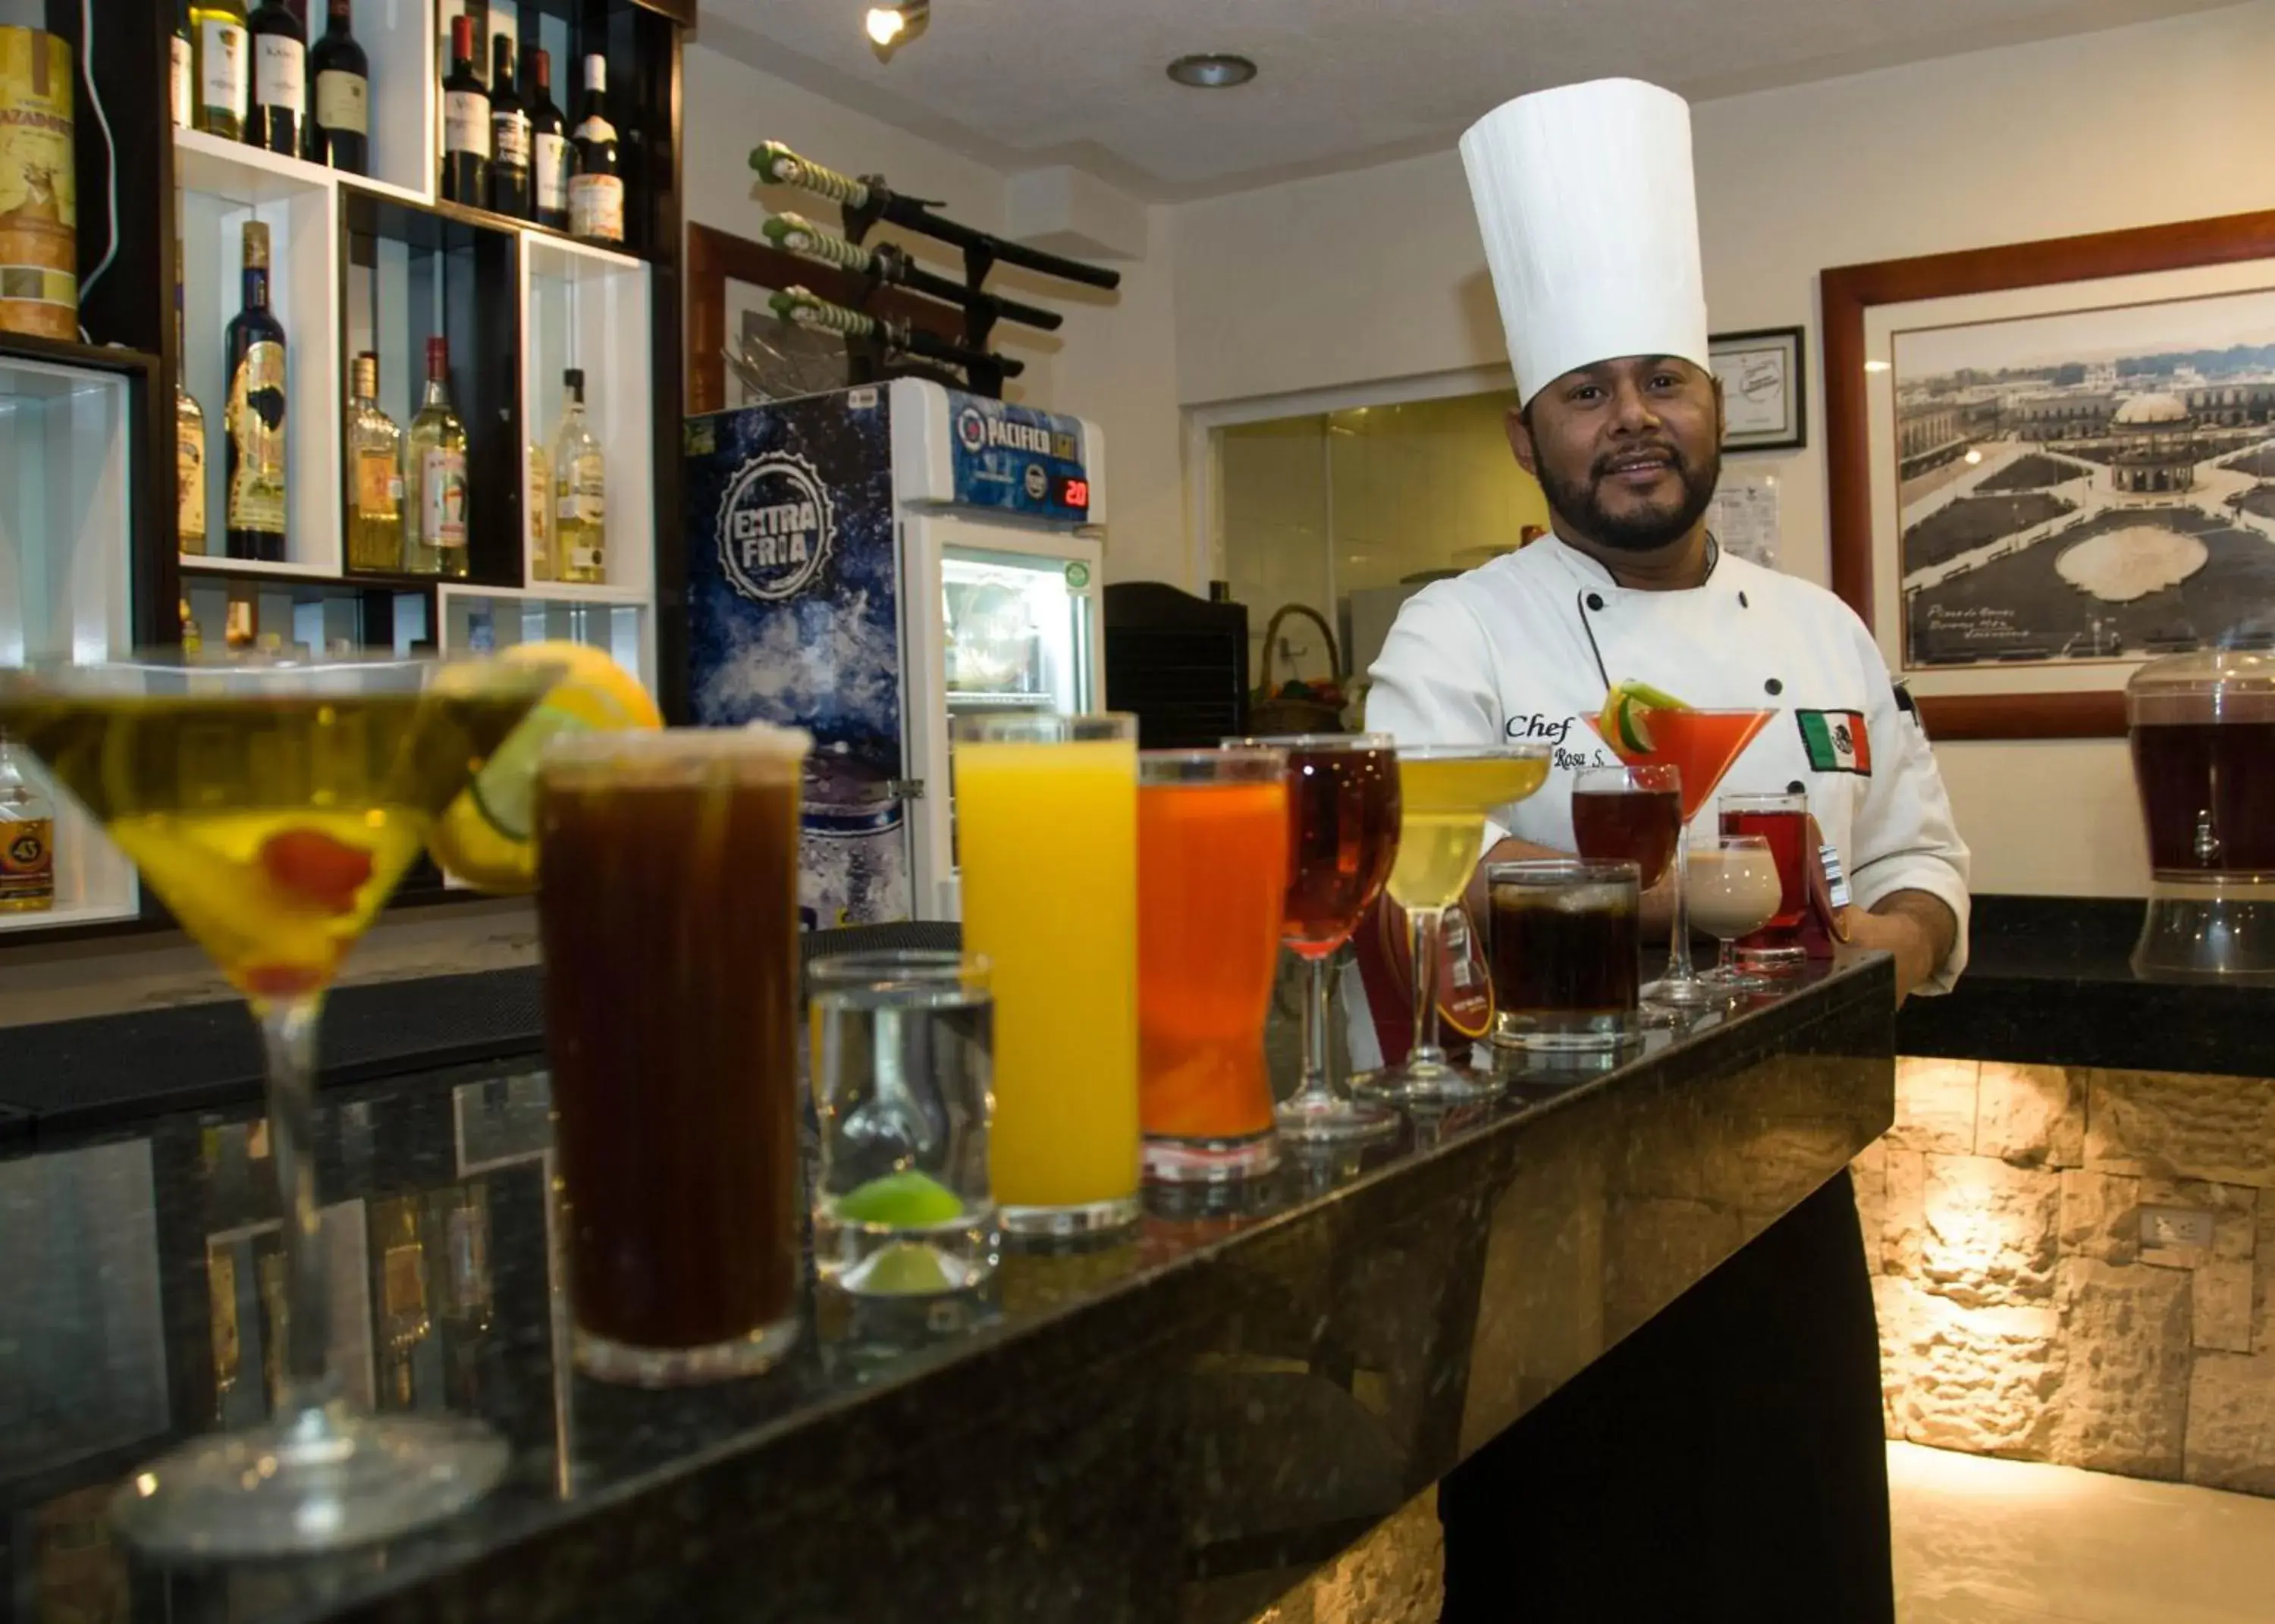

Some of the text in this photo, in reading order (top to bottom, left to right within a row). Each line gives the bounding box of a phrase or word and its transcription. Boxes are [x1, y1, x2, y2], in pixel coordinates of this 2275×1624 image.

[987, 416, 1050, 453] PACIFICO
[1065, 480, 1087, 506] 20
[734, 501, 817, 539] EXTRA
[742, 532, 808, 568] FRIA
[1506, 713, 1576, 745] Chef
[1554, 746, 1605, 770] Rosa S.
